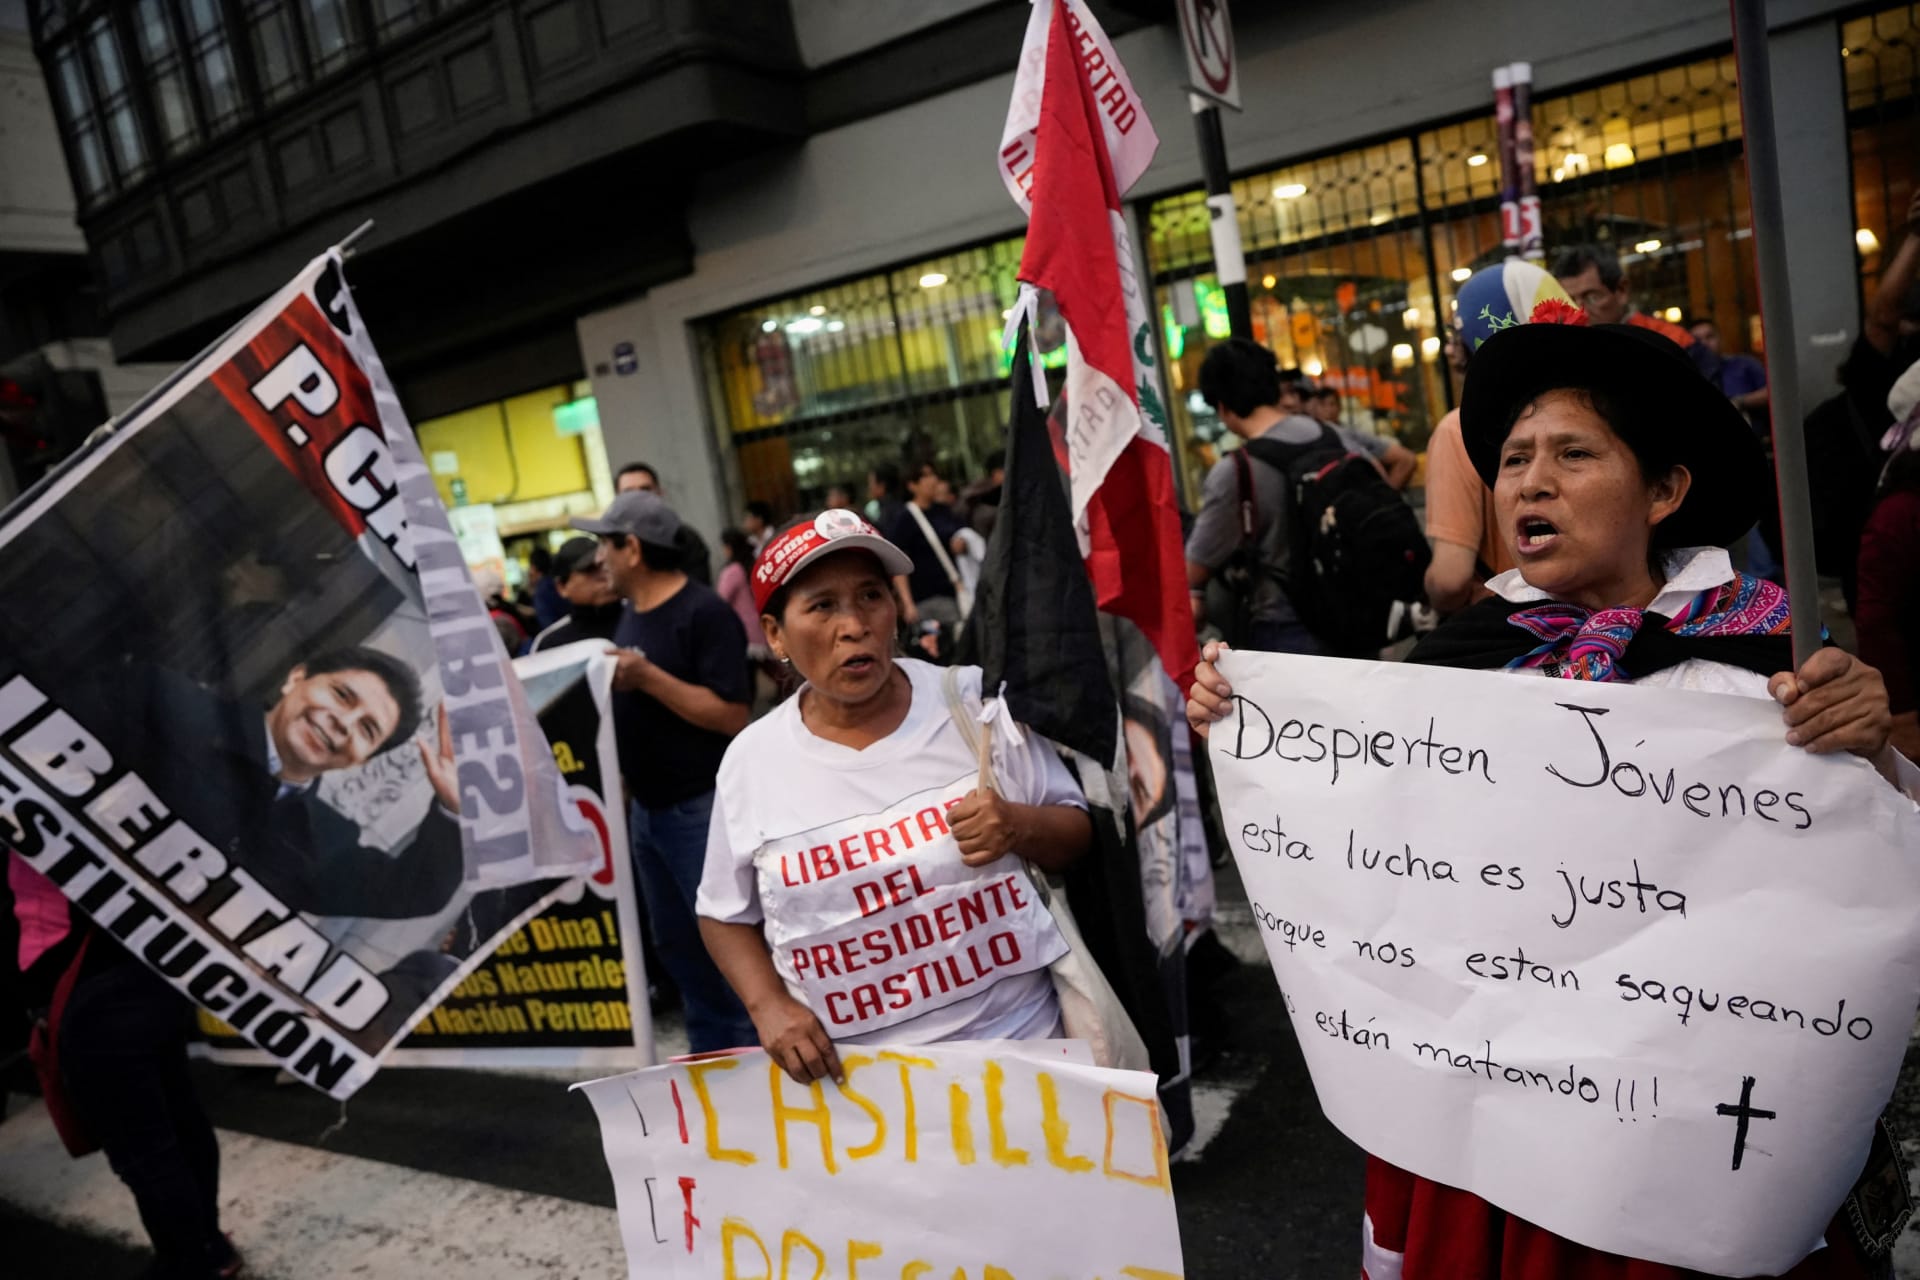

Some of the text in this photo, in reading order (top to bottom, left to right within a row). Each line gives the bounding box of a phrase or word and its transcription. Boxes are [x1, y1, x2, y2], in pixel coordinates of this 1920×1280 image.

[1220, 694, 1812, 829] Despierten Jóvenes
[0, 673, 390, 1032] IBERTAD
[780, 796, 964, 888] LIBERTA
[852, 864, 935, 918] DEL
[1242, 815, 1687, 928] esta lucha es justa
[0, 775, 358, 1092] STITUCIÓN
[791, 875, 1029, 980] PRESIDENTE
[825, 930, 1022, 1025] CASTILLO
[525, 997, 633, 1032] Peruan
[1315, 1008, 1390, 1050] están
[1352, 940, 1416, 968] nos
[1466, 948, 1580, 991] estan
[1616, 971, 1874, 1041] saqueando
